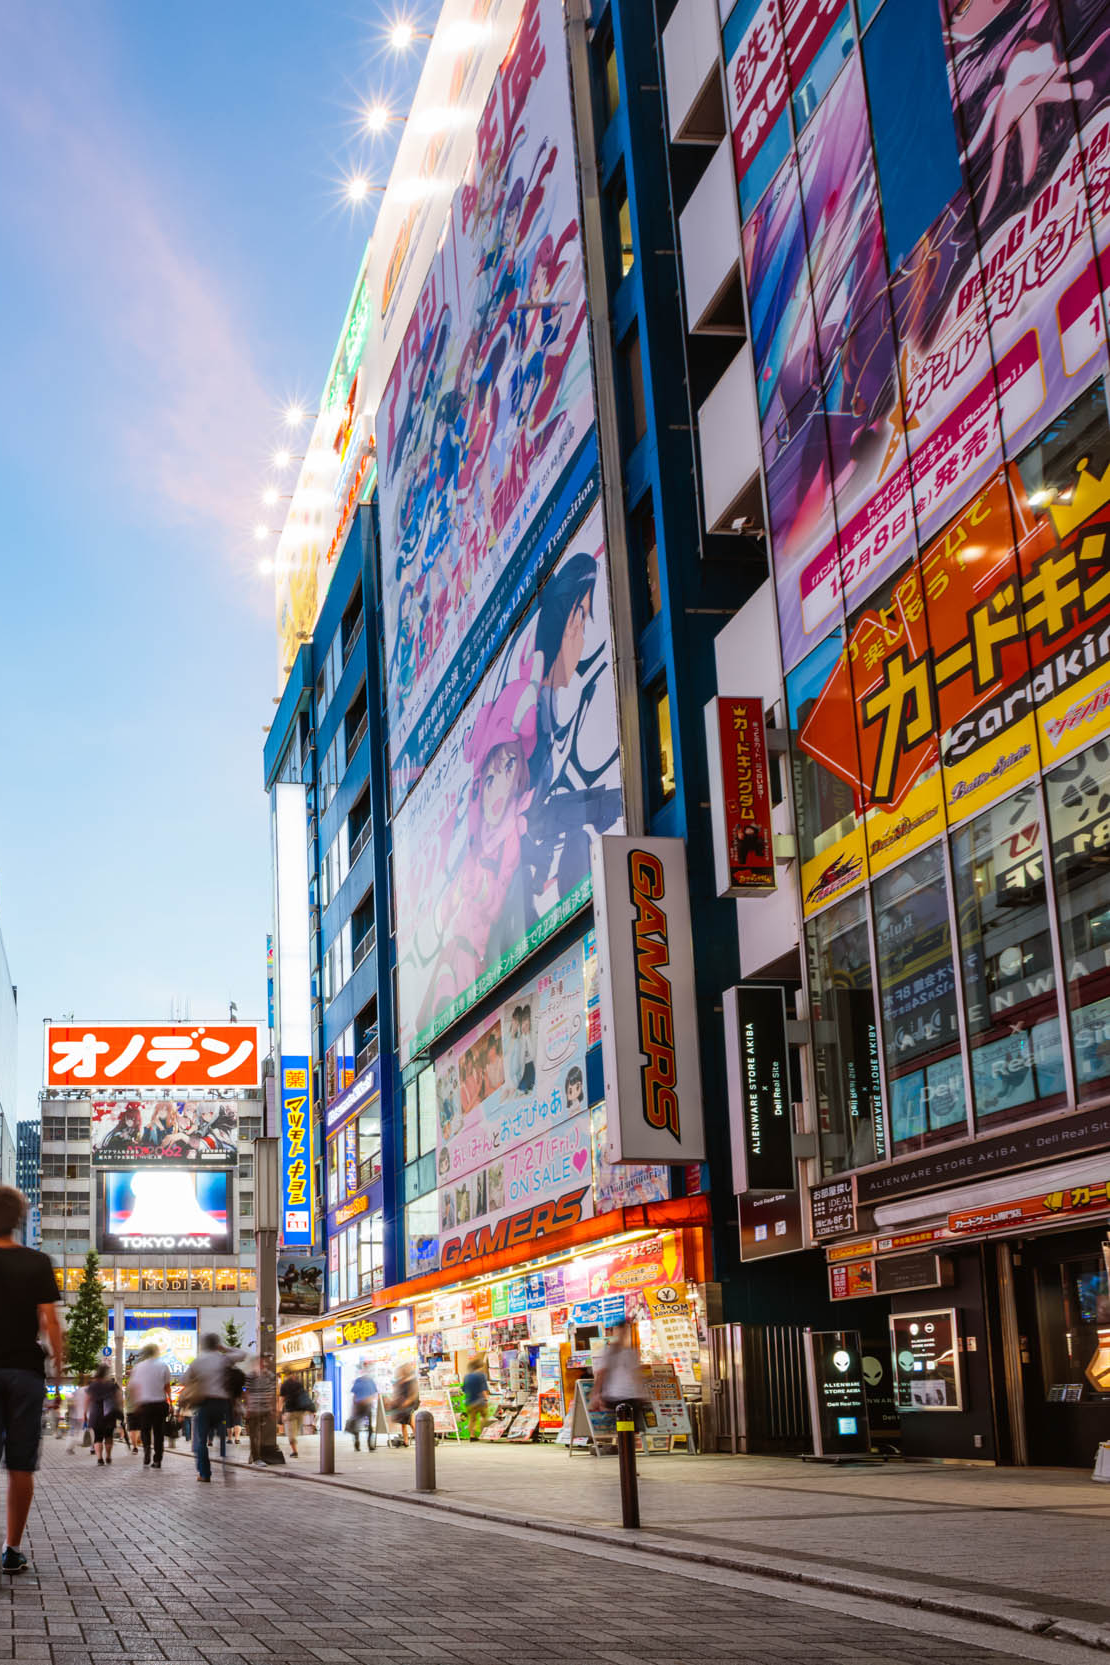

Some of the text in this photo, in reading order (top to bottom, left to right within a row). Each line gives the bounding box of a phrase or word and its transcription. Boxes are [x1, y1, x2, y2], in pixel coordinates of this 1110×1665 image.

[627, 849, 681, 1145] GAMERS
[52, 1026, 254, 1079] オノデン
[746, 1022, 762, 1155] ALIENWARE STORE AKIBA
[772, 1060, 783, 1116] Dell Real Site
[509, 1178, 530, 1200] ON
[532, 1156, 572, 1194] SALE
[869, 1168, 932, 1190] ALIENWARE
[935, 1157, 974, 1176] STORE
[978, 1144, 1018, 1163] AKIBA
[119, 1236, 211, 1249] TOKYO MX
[441, 1184, 591, 1269] GAMERS
[145, 1279, 210, 1291] MODIFY
